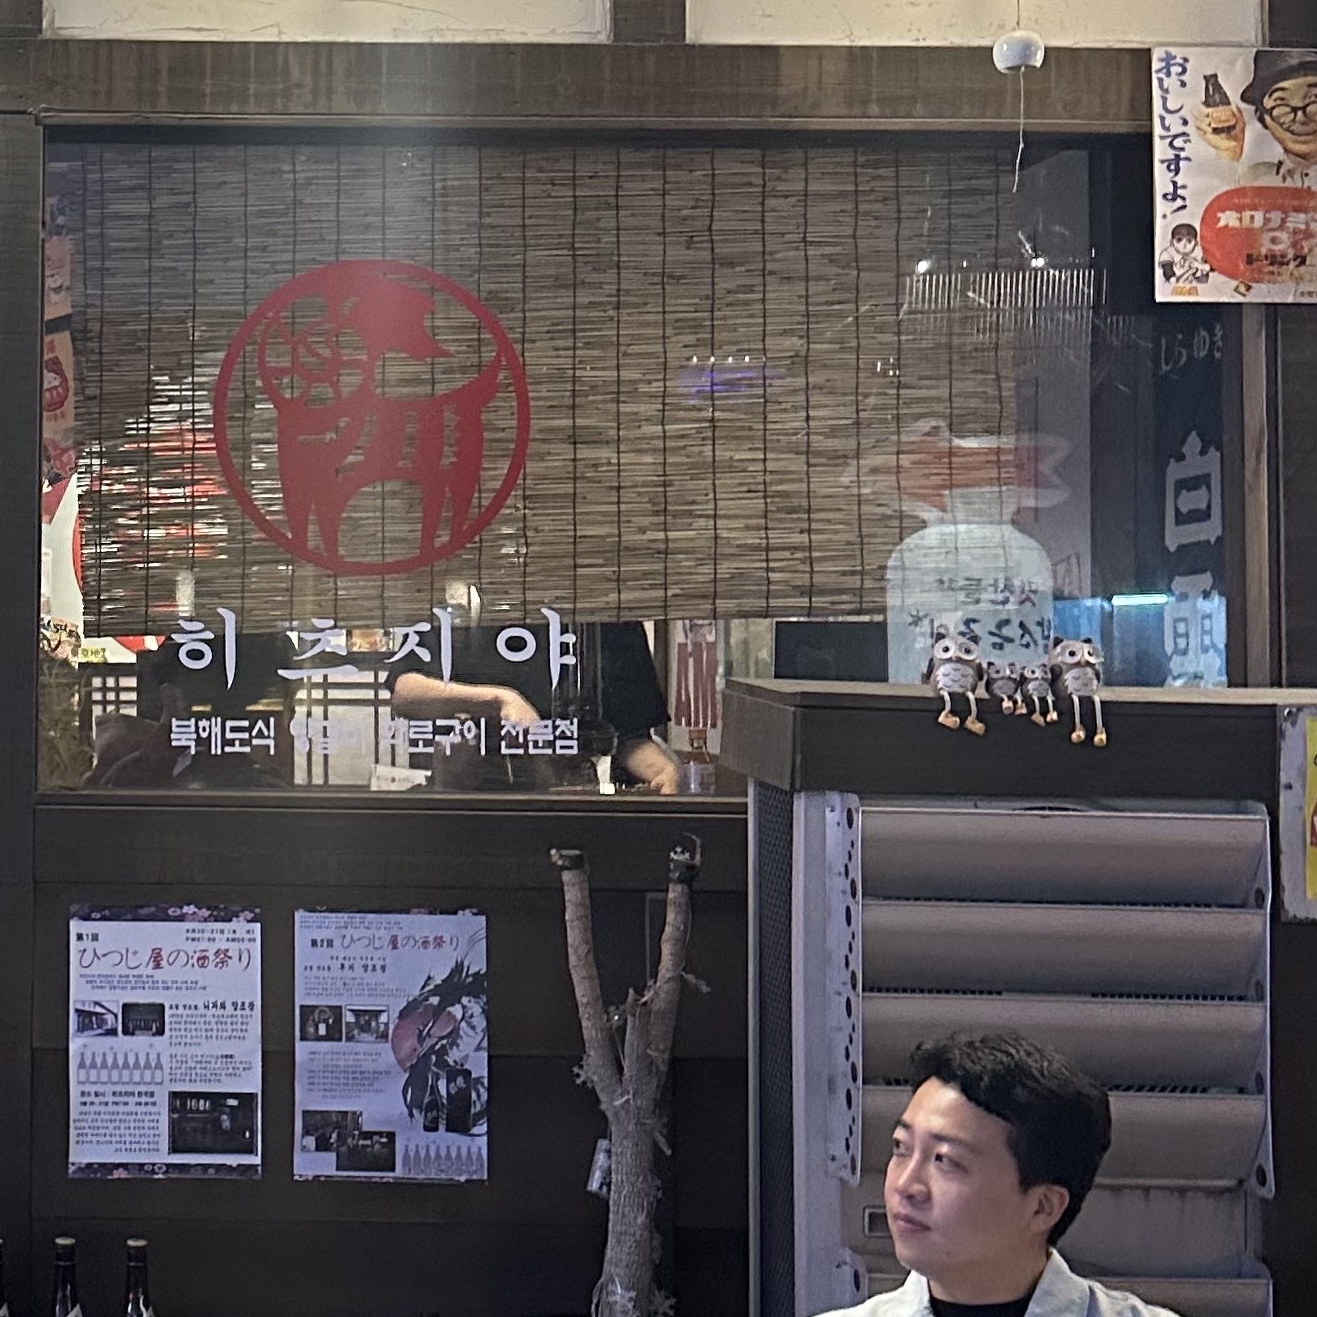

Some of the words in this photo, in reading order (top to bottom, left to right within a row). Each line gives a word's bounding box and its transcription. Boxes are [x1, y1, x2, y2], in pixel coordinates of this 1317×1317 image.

[171, 608, 577, 691] 히츠지야
[171, 717, 275, 755] 북해도식
[379, 717, 486, 755] 화로구이
[500, 717, 579, 755] 전문점
[78, 947, 252, 971] ひつじ屋の酒祭り
